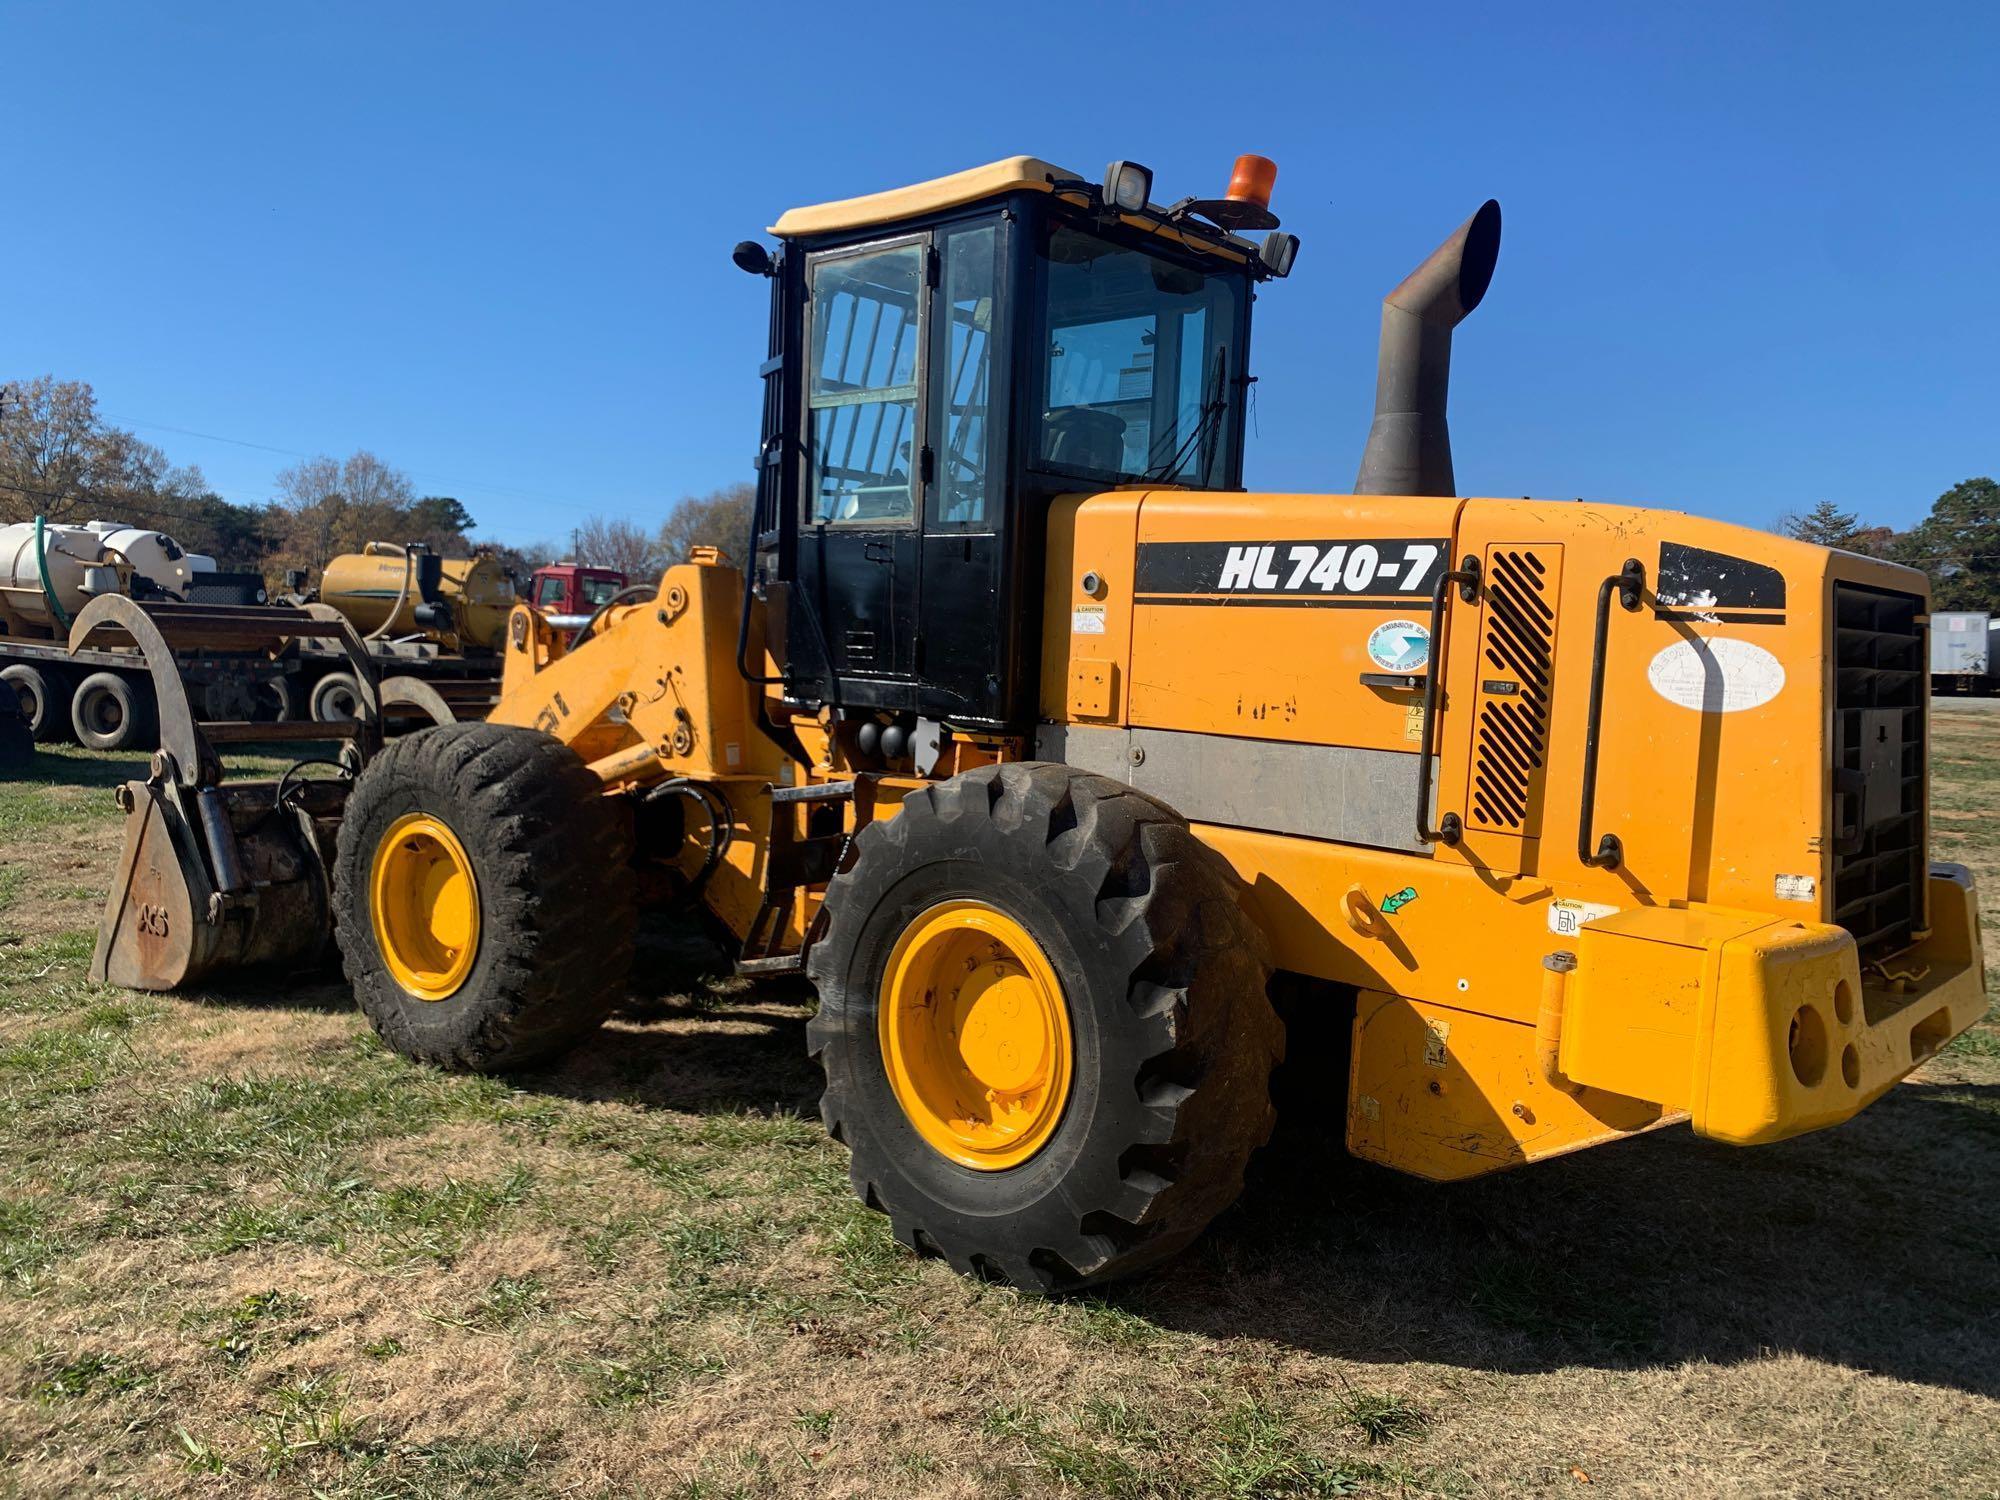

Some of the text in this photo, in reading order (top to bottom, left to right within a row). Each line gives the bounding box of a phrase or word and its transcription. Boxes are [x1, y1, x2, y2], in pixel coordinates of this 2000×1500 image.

[1218, 544, 1438, 592] HL 740-7
[1370, 630, 1380, 646] LOW
[1380, 622, 1414, 633] EMISSION
[1373, 654, 1394, 669] GREEN
[1404, 655, 1426, 670] CLEAN
[1558, 901, 1582, 909] CAUTION
[139, 903, 169, 937] ACS
